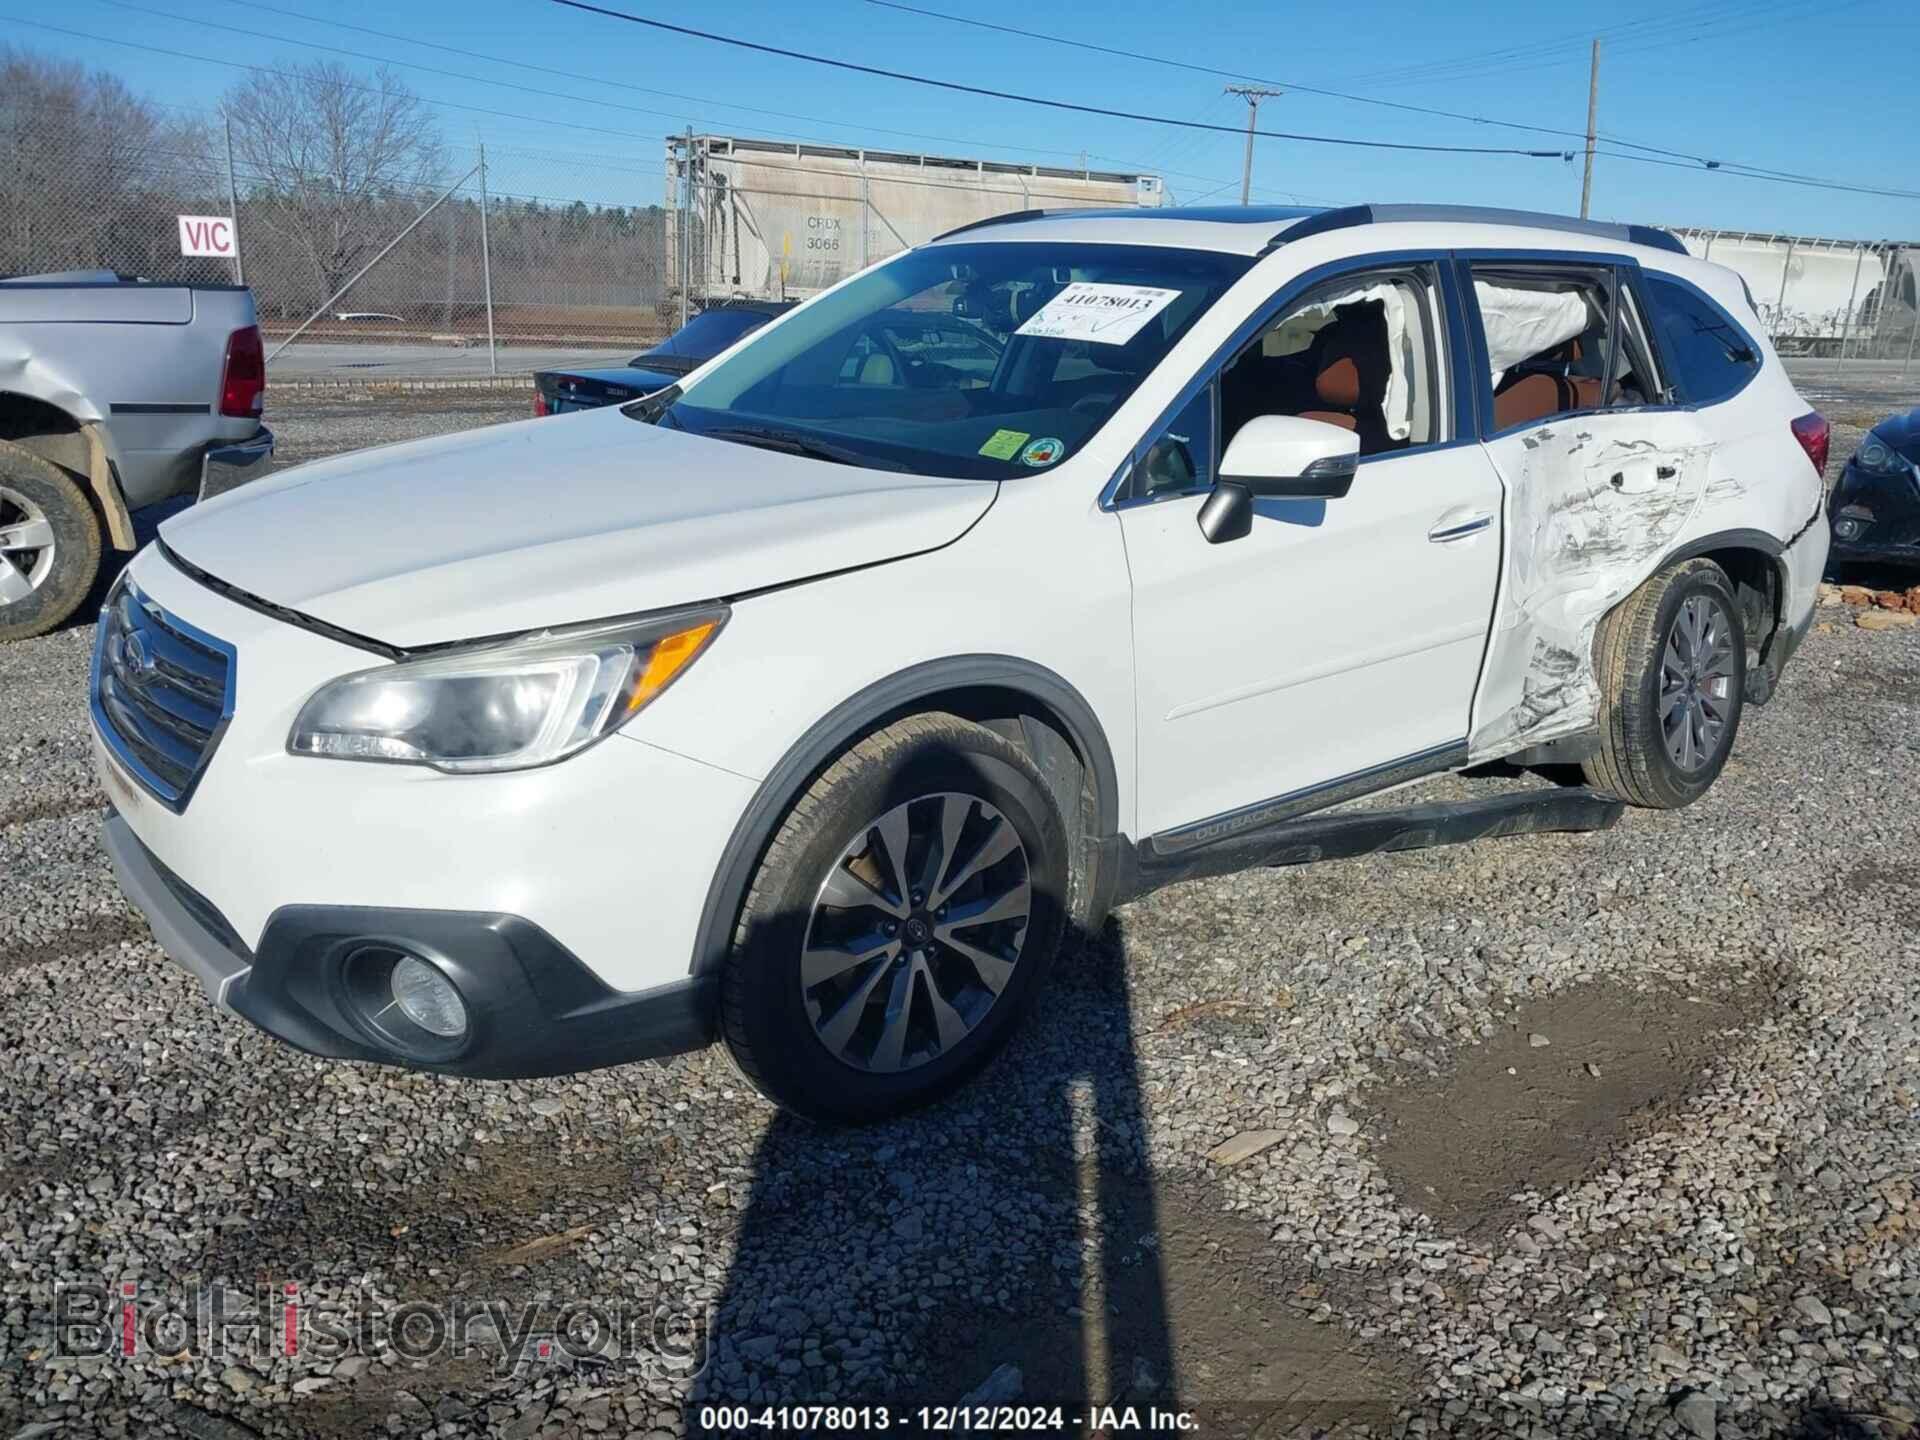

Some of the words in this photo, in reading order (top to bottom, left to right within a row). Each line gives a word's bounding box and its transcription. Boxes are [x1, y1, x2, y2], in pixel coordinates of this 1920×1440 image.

[185, 221, 230, 252] VIC
[1063, 293, 1154, 312] 41078013
[1195, 808, 1278, 840] OUTBACK
